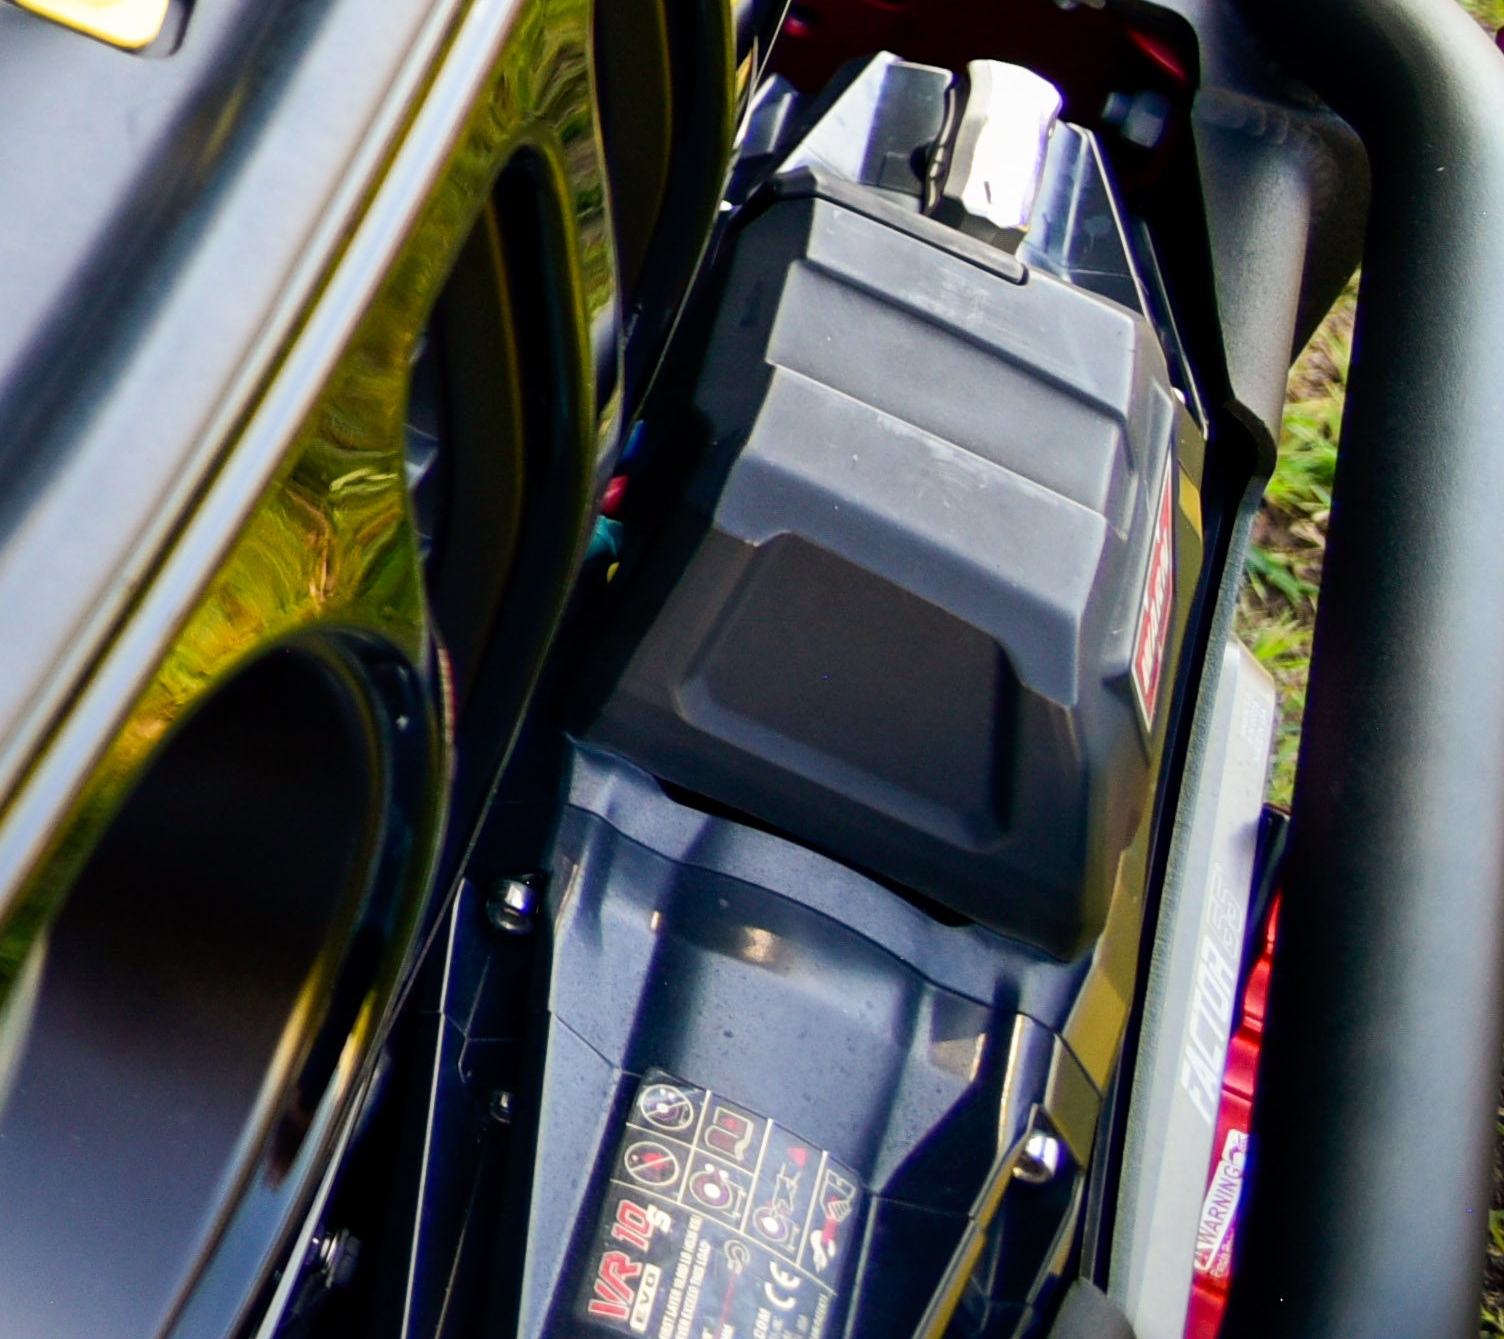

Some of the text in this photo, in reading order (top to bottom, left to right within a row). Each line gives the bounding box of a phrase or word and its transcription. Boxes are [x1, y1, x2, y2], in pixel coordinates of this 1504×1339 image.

[1179, 935, 1234, 1124] FACTOR
[1196, 1164, 1242, 1241] WARNING
[586, 1247, 644, 1319] VR
[633, 1270, 657, 1324] EVO
[664, 1288, 682, 1316] LAYER
[679, 1251, 692, 1264] LB
[680, 1284, 699, 1319] EXCEED
[695, 1238, 712, 1266] LOAD
